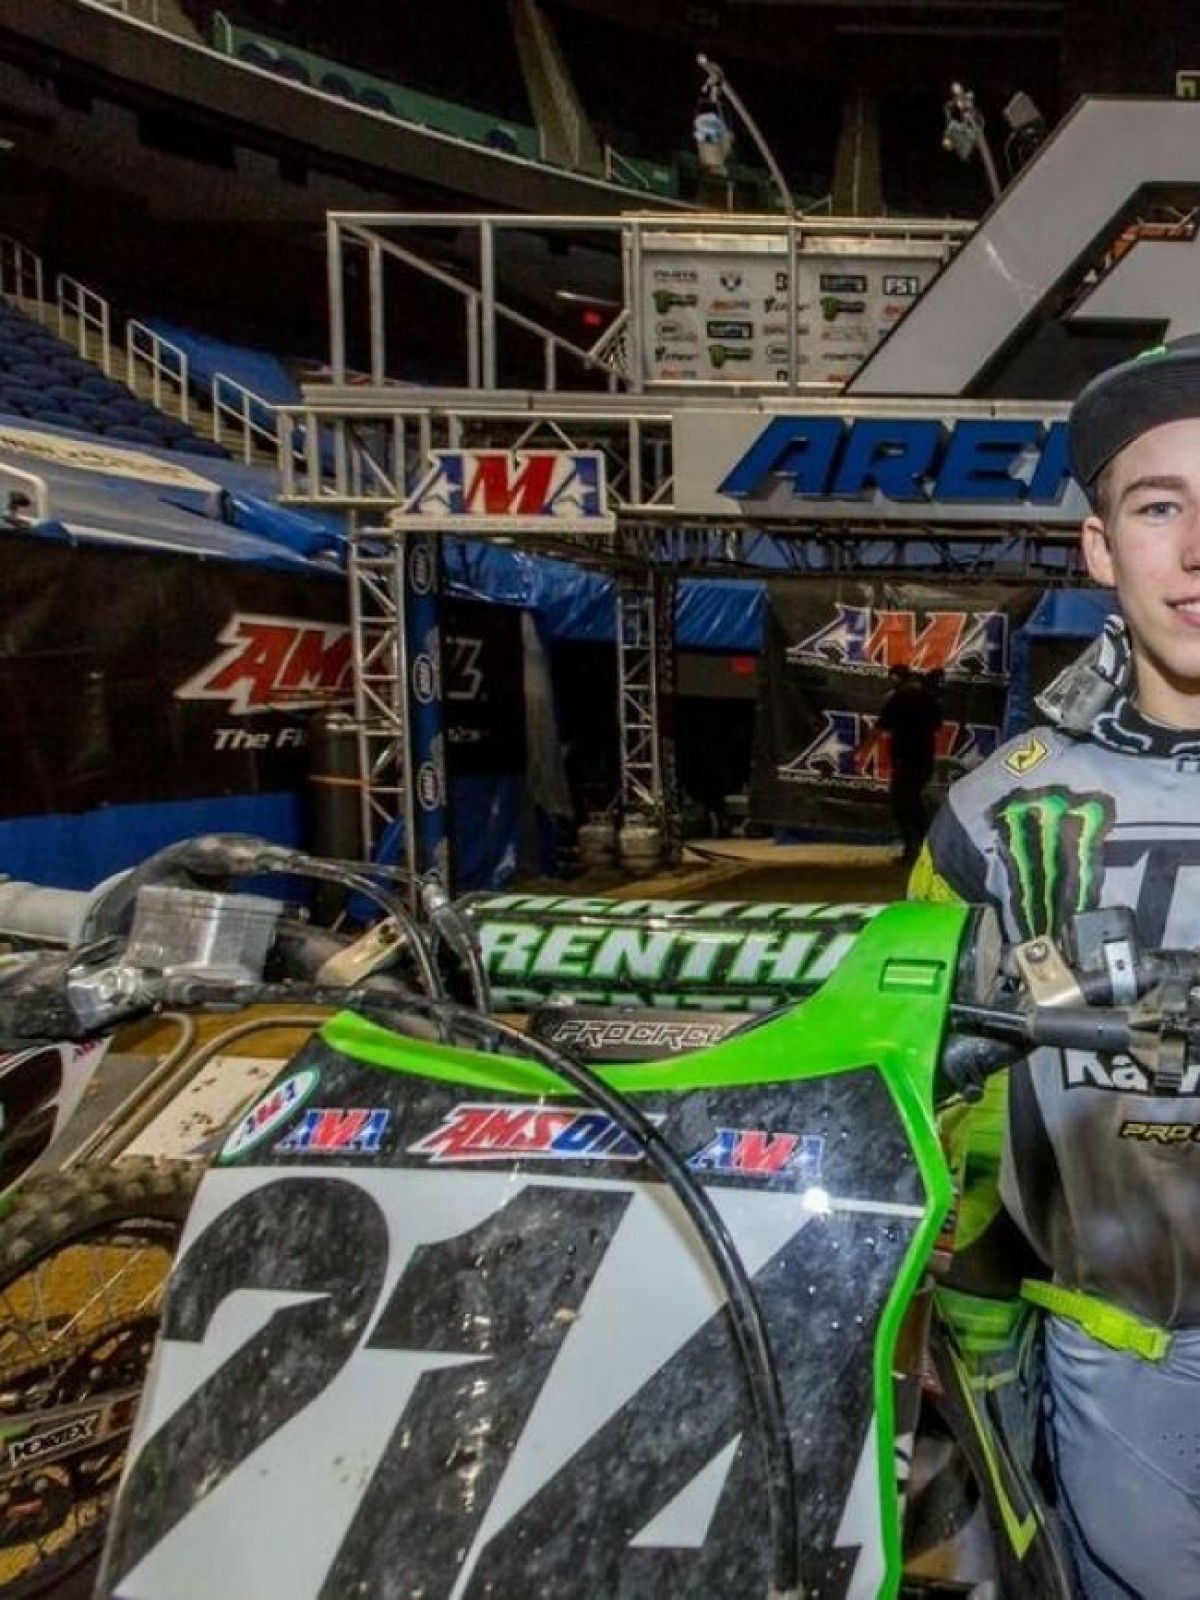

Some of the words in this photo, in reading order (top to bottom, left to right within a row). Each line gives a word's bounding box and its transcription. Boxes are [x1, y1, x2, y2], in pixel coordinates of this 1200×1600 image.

[402, 452, 606, 516] AMA
[787, 603, 1009, 674] AMA
[213, 729, 270, 750] The
[276, 1109, 389, 1151] AMA
[688, 1129, 826, 1178] AMA
[103, 1176, 925, 1600] 214
